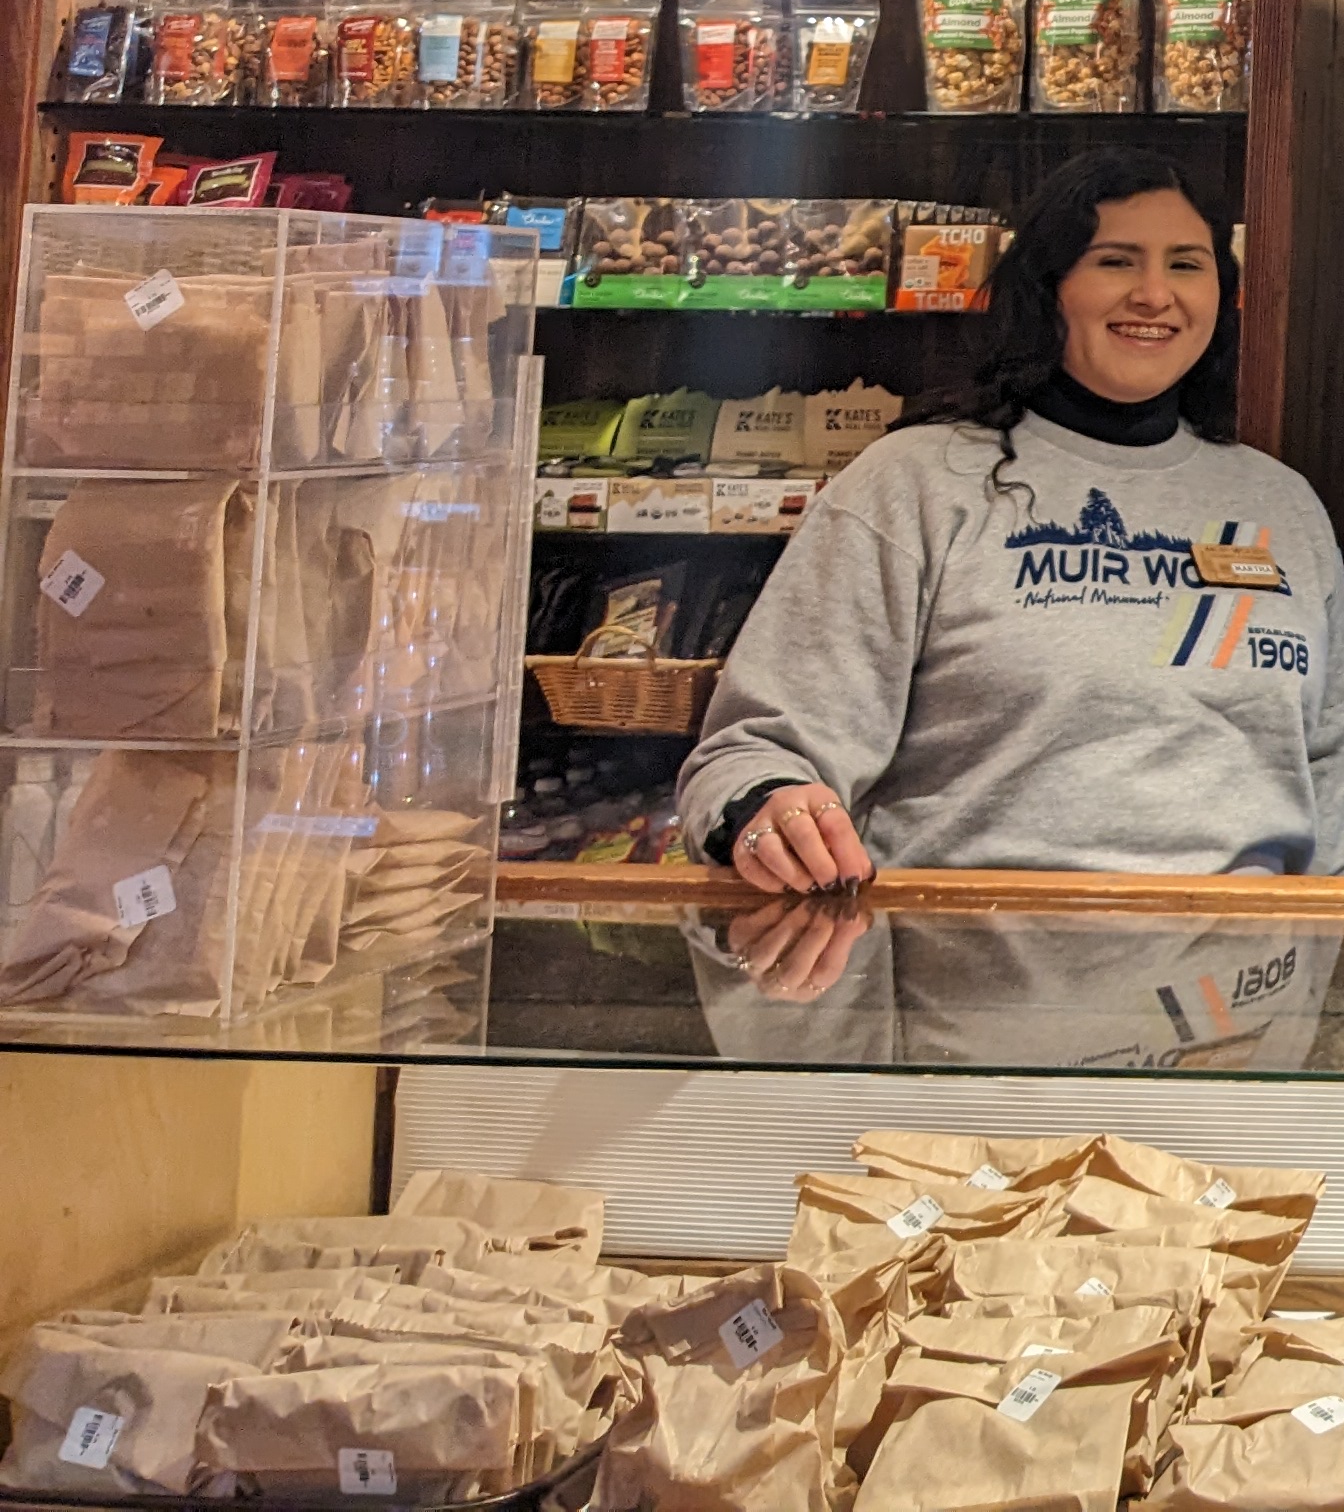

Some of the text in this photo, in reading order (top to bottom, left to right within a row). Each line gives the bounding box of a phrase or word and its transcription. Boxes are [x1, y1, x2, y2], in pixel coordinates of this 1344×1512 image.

[941, 17, 982, 27] Almond
[1052, 14, 1091, 24] Almond
[1174, 12, 1214, 22] Almond
[939, 228, 986, 245] TCHO
[915, 292, 965, 310] TCHO
[756, 411, 794, 425] KATE'S
[844, 408, 882, 422] KATE'S
[1015, 547, 1131, 589] MUIR
[1023, 586, 1164, 609] National Monument
[1247, 636, 1309, 676] 1908
